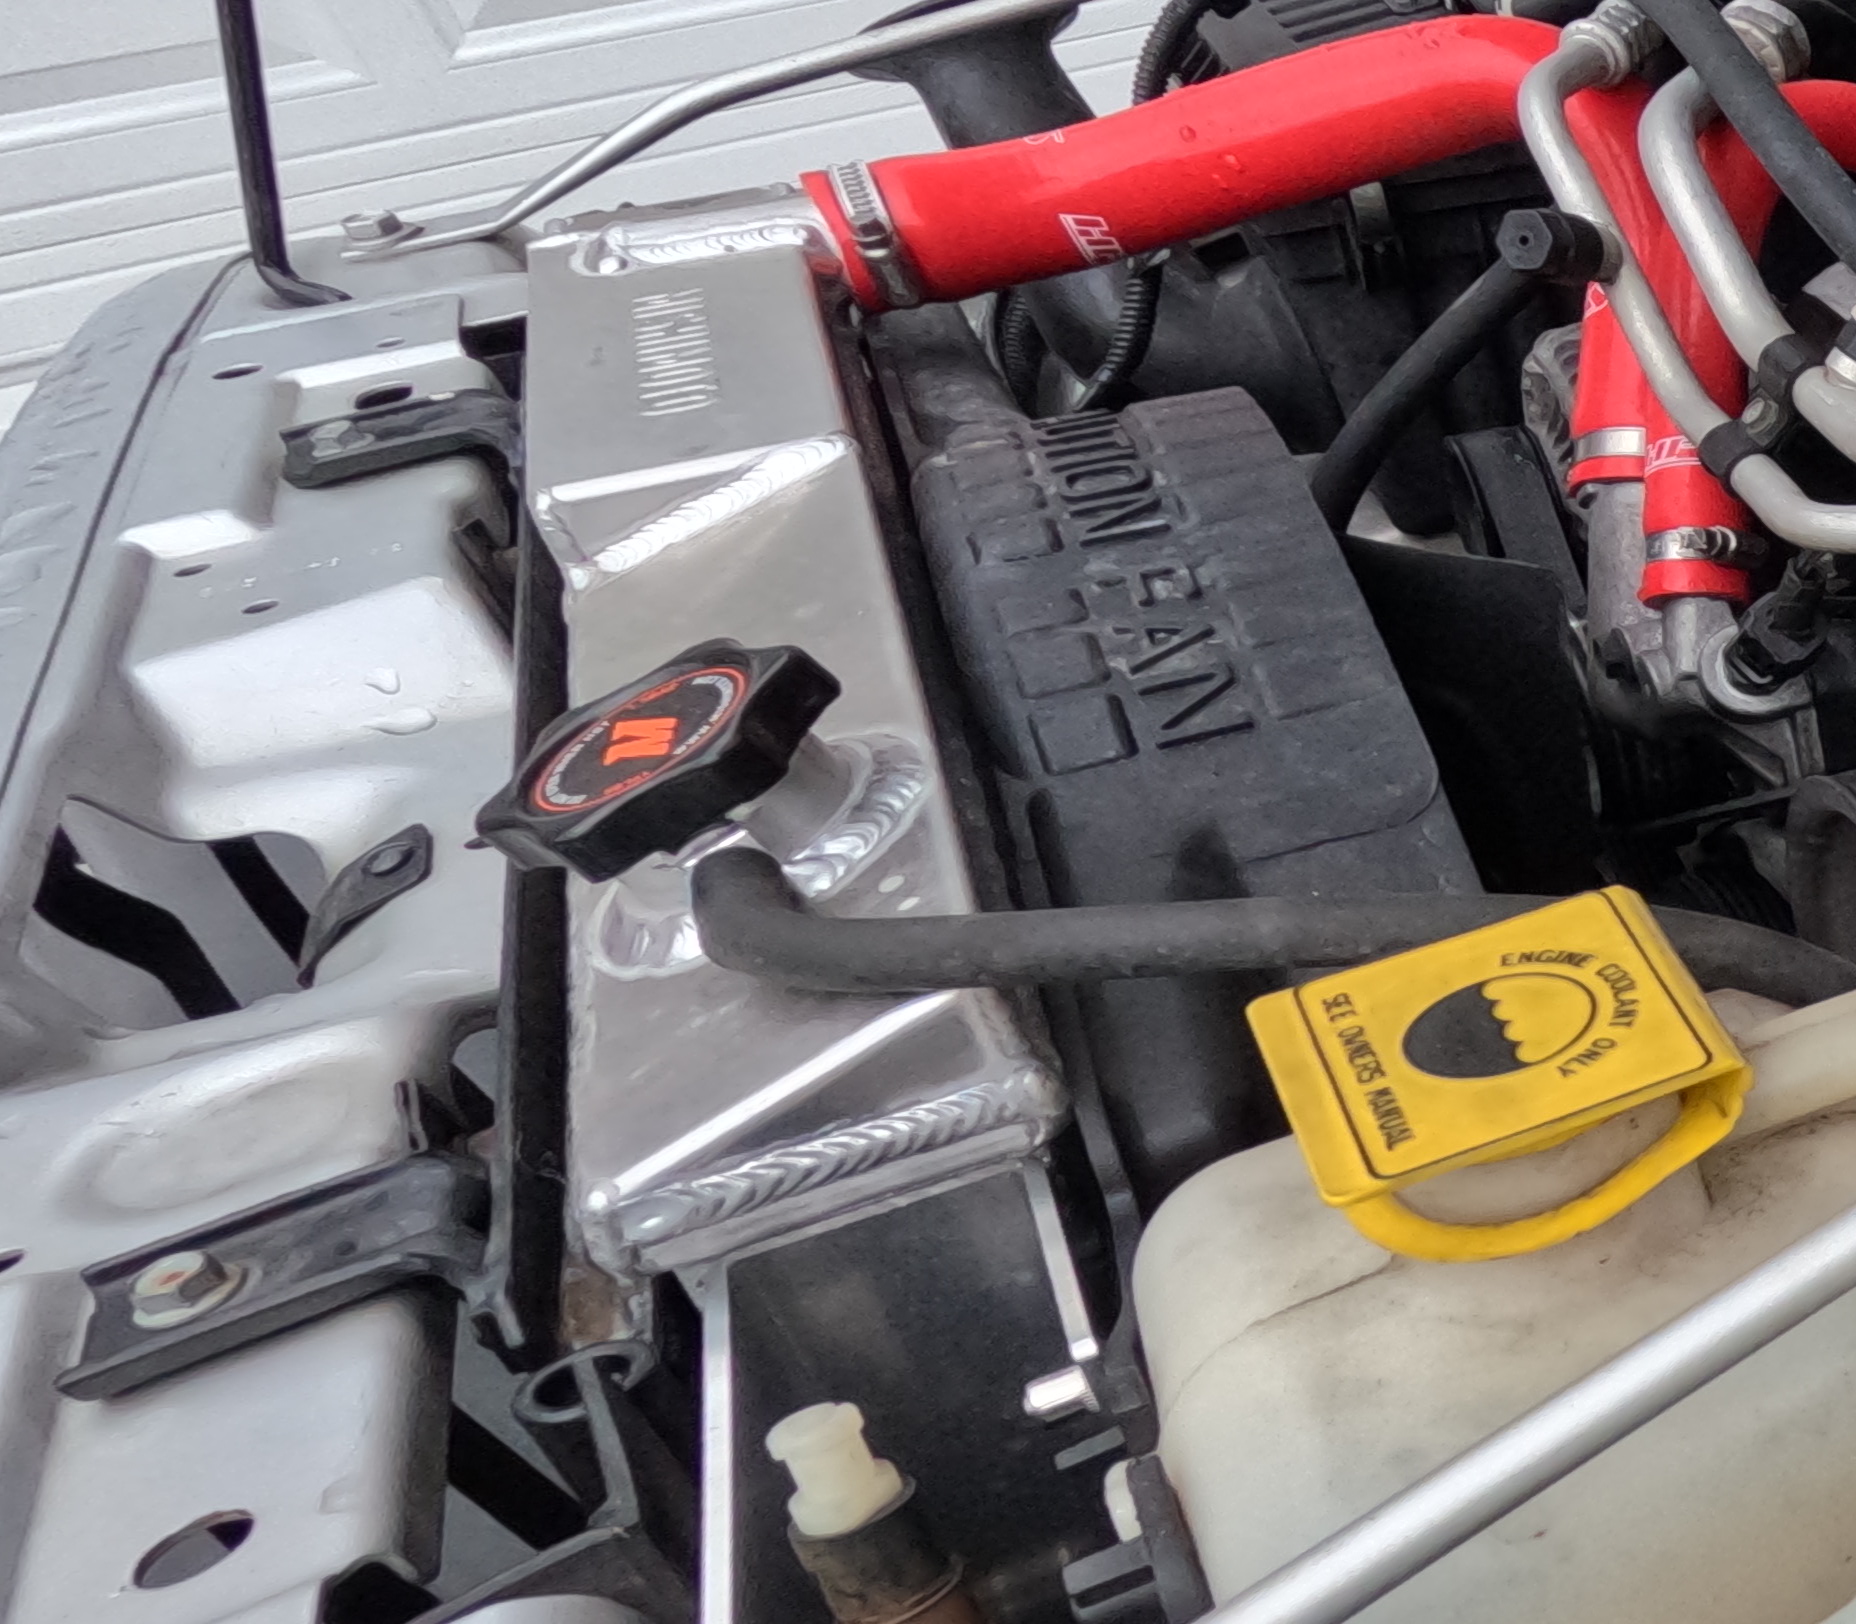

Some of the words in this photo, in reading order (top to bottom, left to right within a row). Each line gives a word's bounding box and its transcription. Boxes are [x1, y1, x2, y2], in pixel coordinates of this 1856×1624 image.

[1499, 948, 1598, 969] ENGINE
[1321, 991, 1359, 1023] SEE
[1595, 962, 1640, 1029] COOLANT
[1337, 1024, 1387, 1086] OWNERS
[1559, 1036, 1618, 1078] ONLY
[1363, 1085, 1415, 1151] MANUAL
